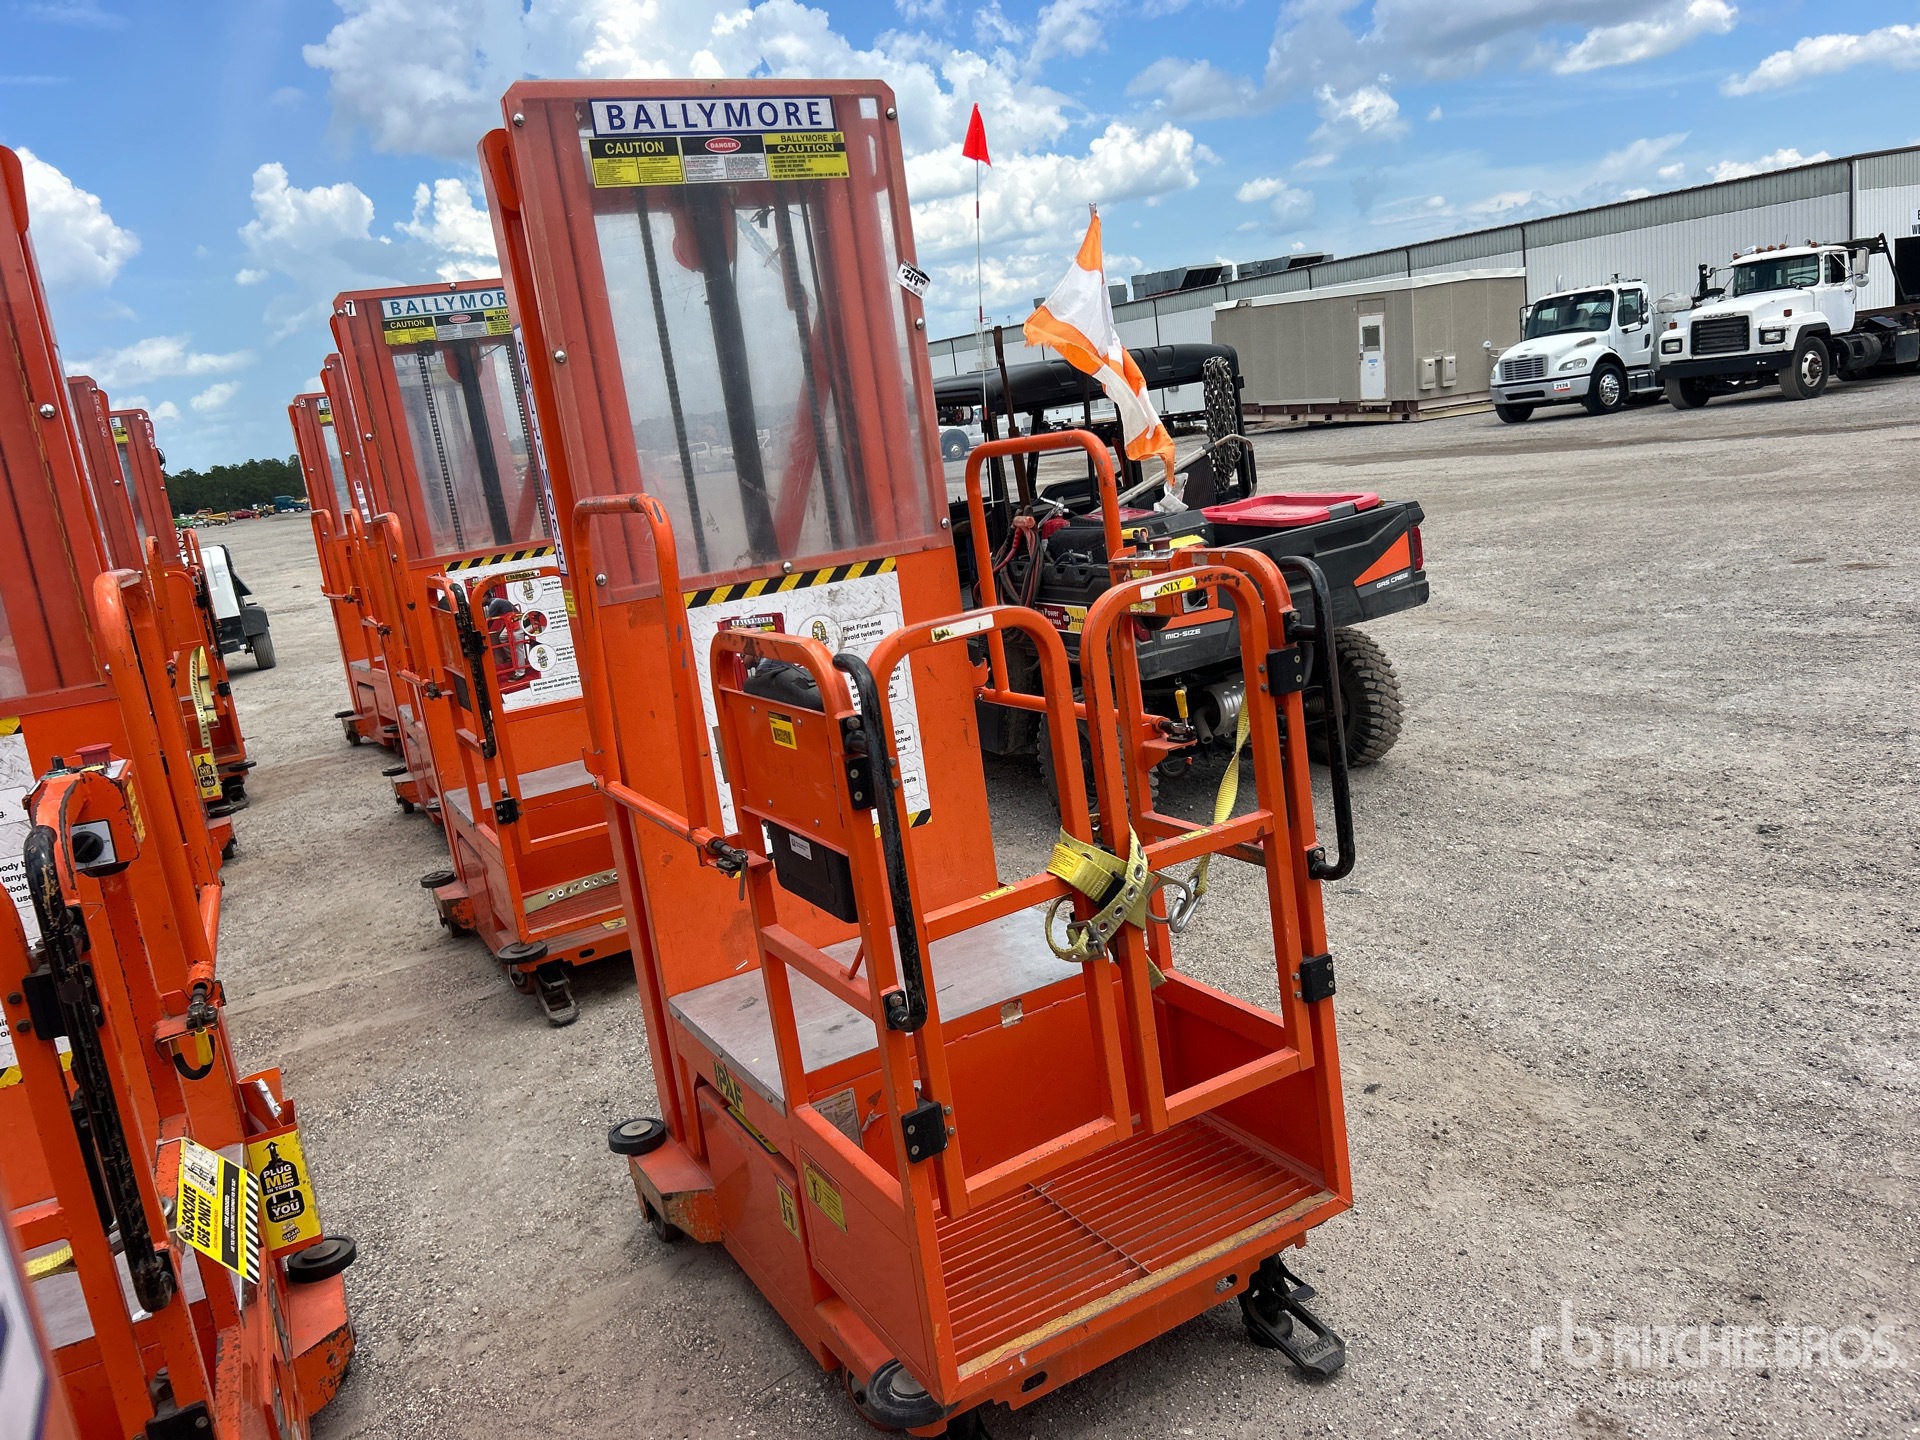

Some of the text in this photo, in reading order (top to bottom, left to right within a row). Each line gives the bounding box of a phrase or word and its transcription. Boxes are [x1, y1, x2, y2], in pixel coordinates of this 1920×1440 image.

[606, 101, 823, 131] BALLYMORE
[781, 134, 828, 143] BALLYMORE
[604, 141, 665, 155] CAUTION
[777, 143, 835, 153] CAUTION
[389, 292, 508, 316] BALLYMOR
[389, 319, 426, 329] CAUTION
[1376, 579, 1390, 589] GAS
[1043, 607, 1059, 617] Power
[842, 620, 882, 633] Feet First and
[843, 628, 884, 641] avoid twisting.
[1165, 628, 1201, 640] MID-SIZE
[904, 776, 917, 784] rails
[2, 872, 27, 884] lanya
[263, 1164, 292, 1179] PLUG
[264, 1171, 294, 1190] ME
[275, 1182, 295, 1192] TODAY
[181, 1183, 197, 1243] ASSOCIATE
[272, 1201, 300, 1217] YOU
[197, 1194, 212, 1248] USE ONLY!
[273, 1210, 301, 1221] TOMORROW
[283, 1228, 300, 1240] GEAR
[288, 1234, 297, 1242] UP
